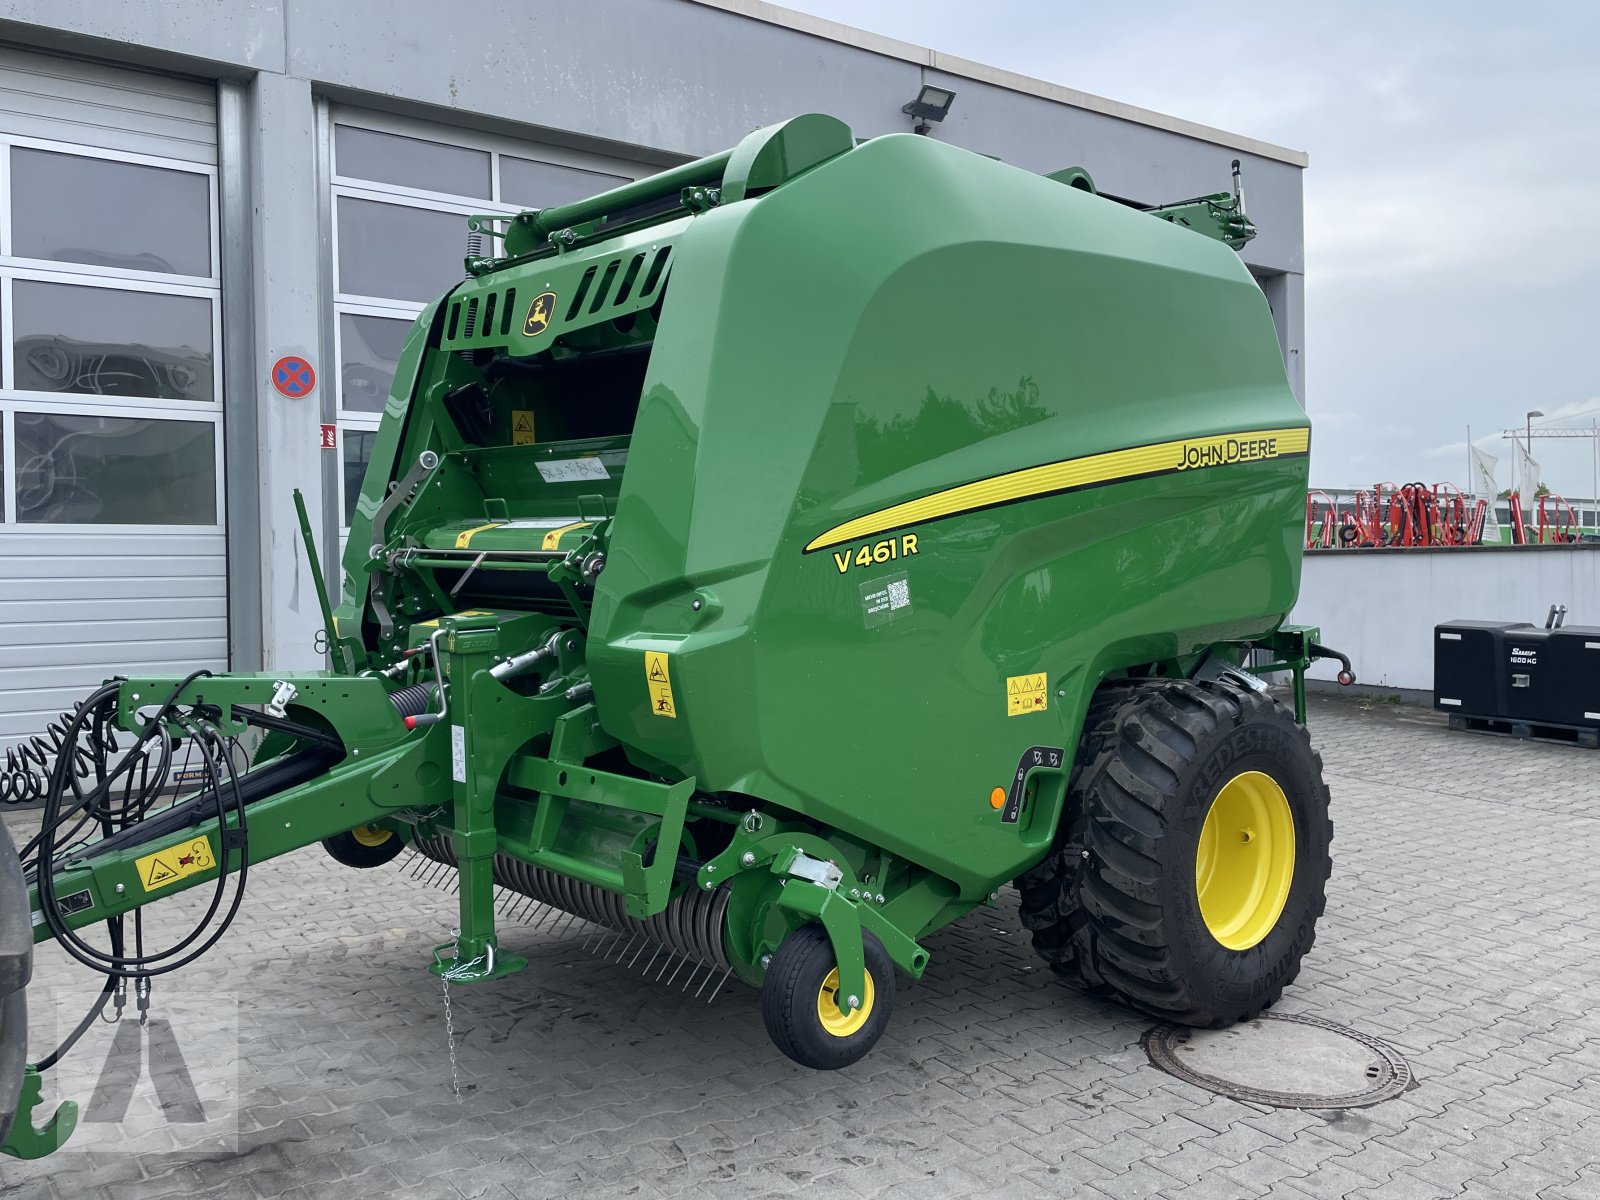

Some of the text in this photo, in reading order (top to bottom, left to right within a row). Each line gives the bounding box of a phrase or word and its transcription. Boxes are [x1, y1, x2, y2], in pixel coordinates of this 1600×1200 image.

[1177, 438, 1277, 468] JOHN DEERE
[833, 532, 919, 574] V 461 R
[1510, 656, 1527, 664] 1600
